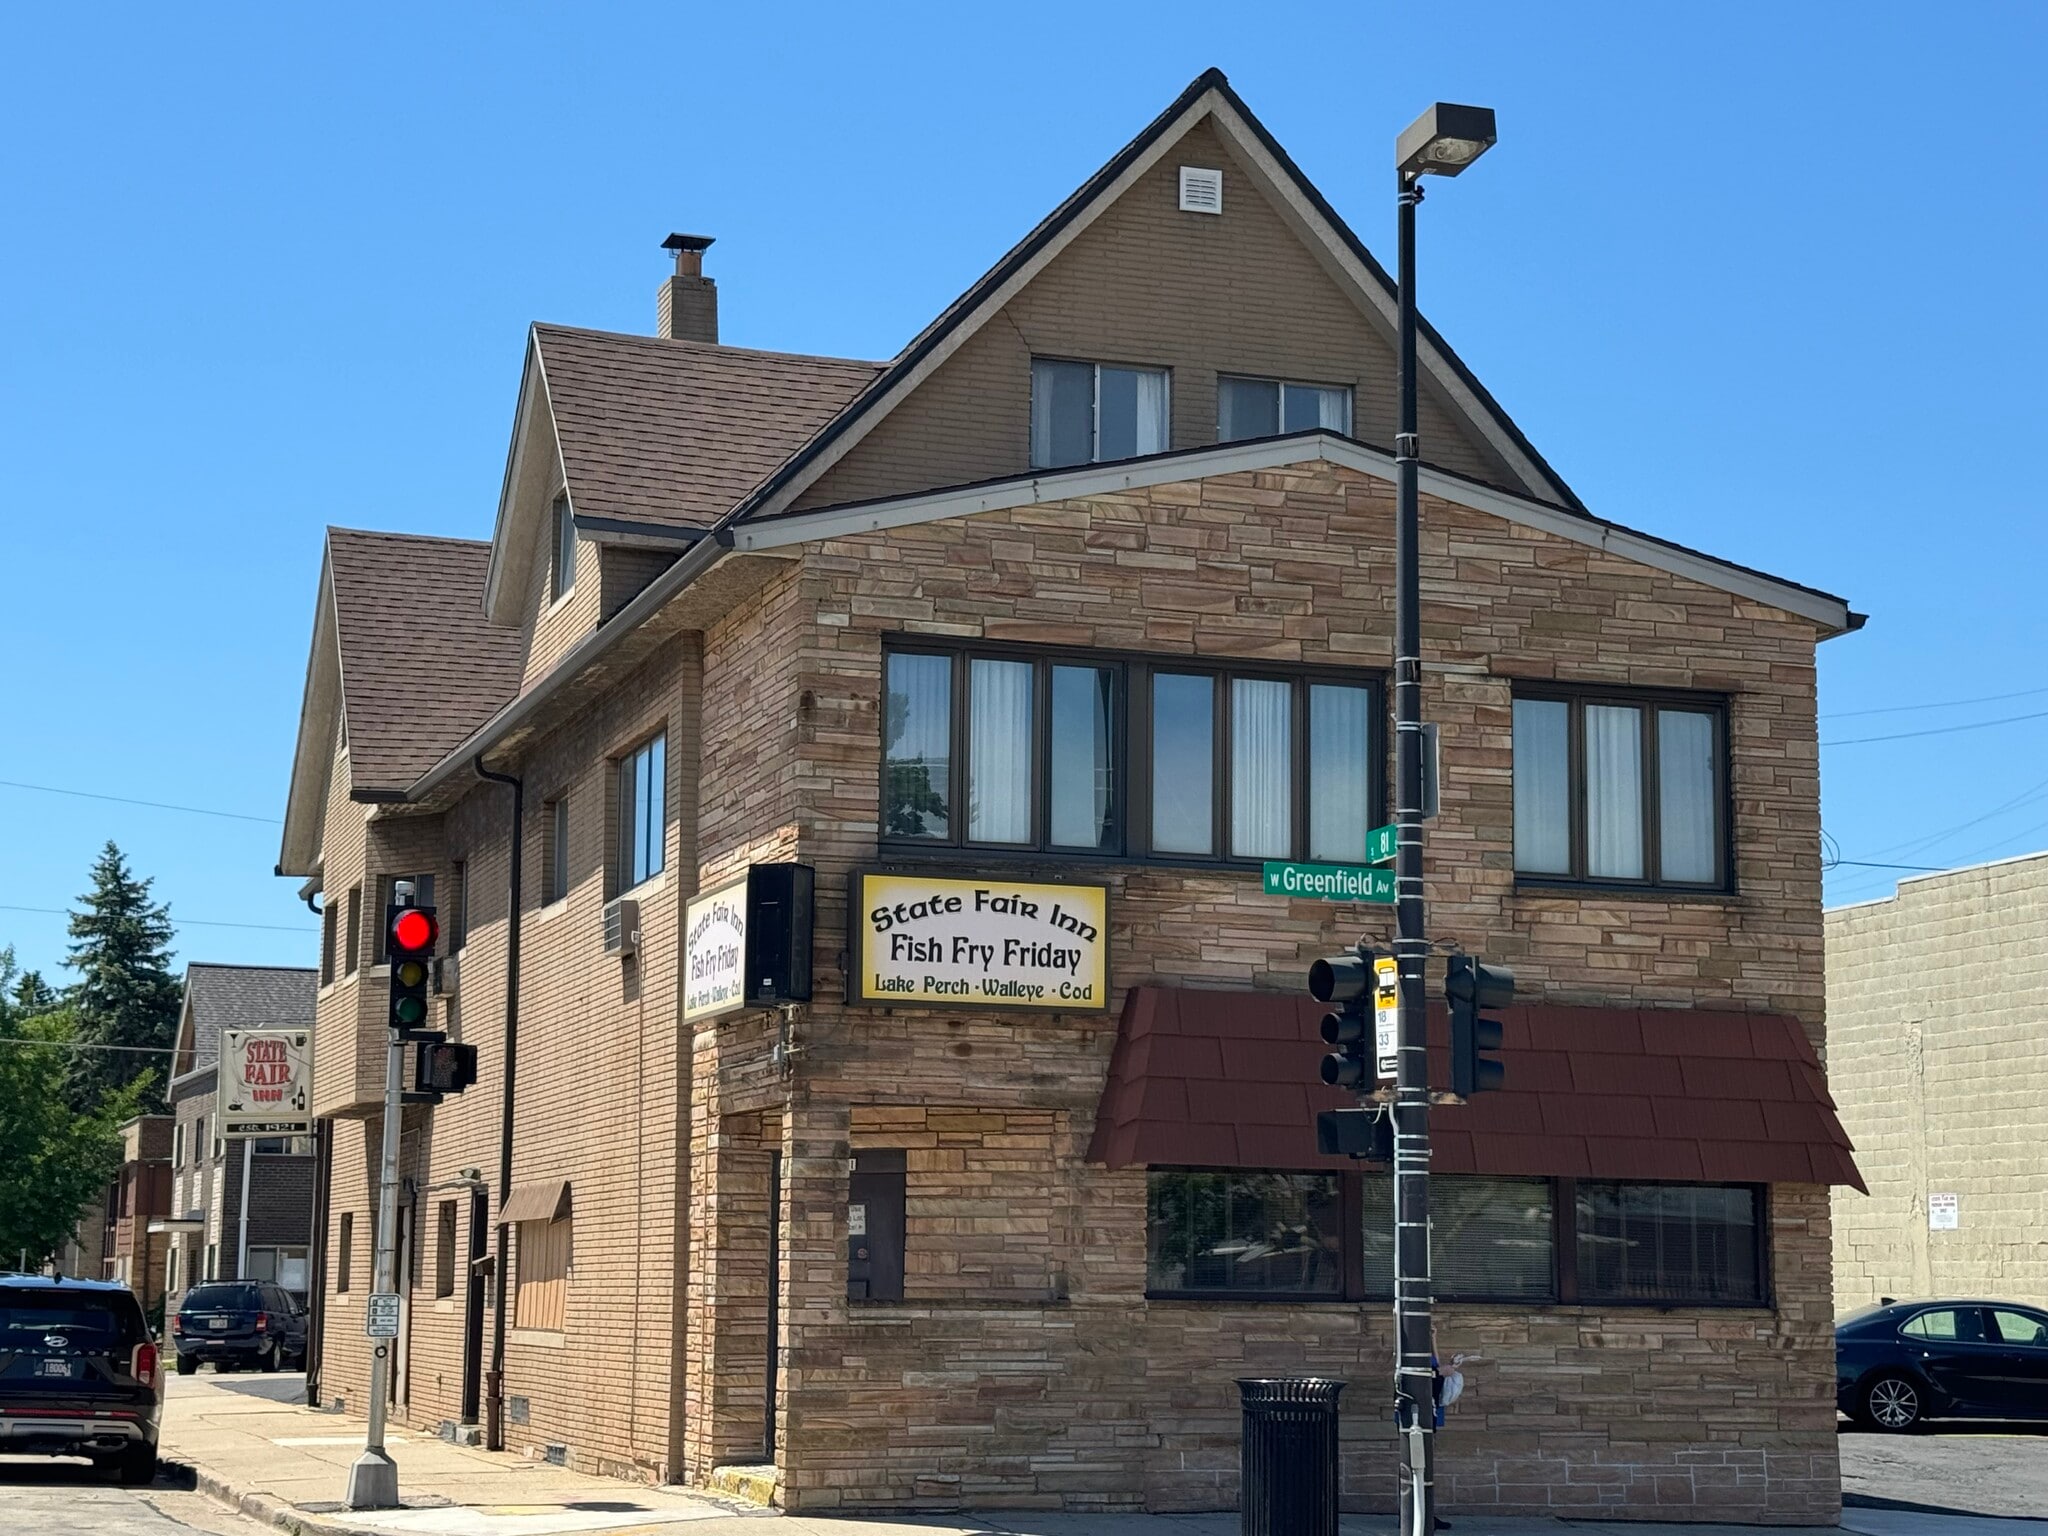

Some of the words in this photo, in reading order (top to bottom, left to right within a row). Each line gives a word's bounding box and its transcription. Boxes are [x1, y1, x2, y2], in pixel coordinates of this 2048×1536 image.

[1380, 831, 1389, 853] 81
[1270, 873, 1279, 887] W
[1283, 867, 1373, 896] Greenfield
[1376, 880, 1389, 893] Av
[870, 894, 963, 933] State
[975, 889, 1039, 920] Fair
[1049, 904, 1098, 943] Inn
[688, 912, 711, 955] State
[730, 904, 744, 937] Inn
[691, 953, 705, 981] Fish
[705, 949, 717, 980] Fry
[717, 944, 739, 974] Friday
[890, 933, 943, 963] Fish
[951, 936, 995, 972] Fry
[1003, 938, 1082, 976] Friday
[874, 973, 915, 993] Lake
[923, 975, 970, 995] Perch
[982, 978, 1044, 1002] Walleye
[1059, 981, 1092, 1000] Cod
[1378, 1010, 1387, 1023] 18
[1379, 1033, 1389, 1046] 33
[246, 1040, 288, 1063] STATE
[244, 1064, 291, 1085] FAIR
[252, 1089, 283, 1102] INN
[266, 1123, 295, 1131] 1921
